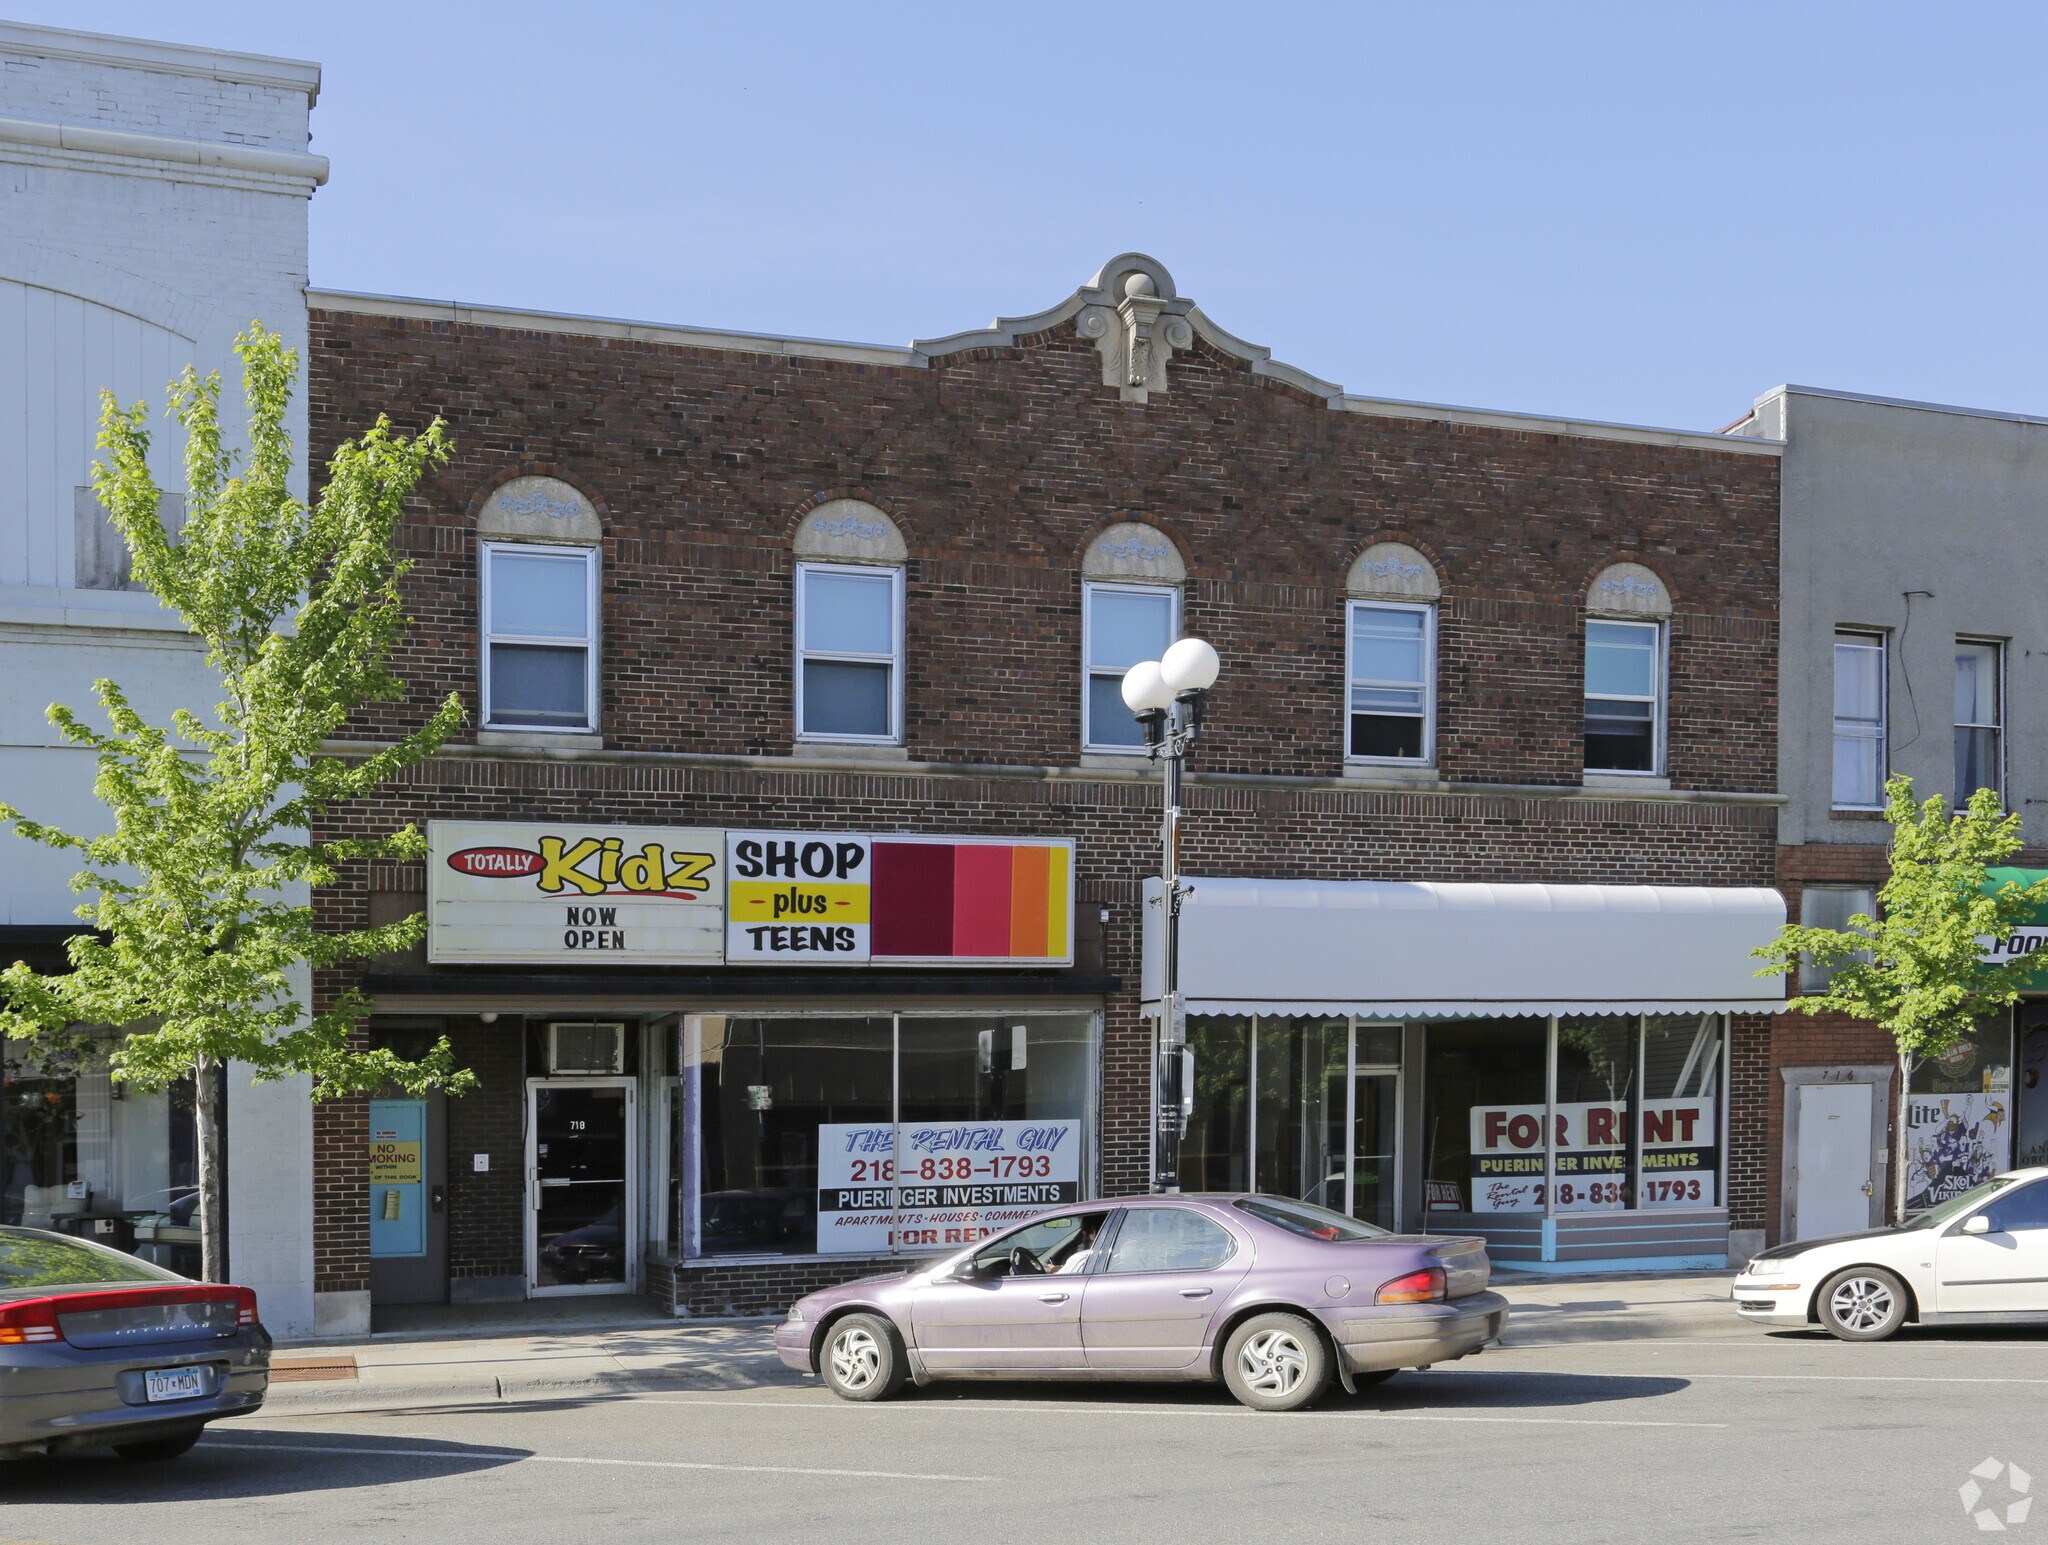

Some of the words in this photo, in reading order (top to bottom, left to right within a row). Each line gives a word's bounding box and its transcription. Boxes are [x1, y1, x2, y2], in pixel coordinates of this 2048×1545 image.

[462, 852, 534, 872] TOTALLY
[536, 836, 716, 896] Kidz
[735, 840, 864, 880] SHOP
[773, 887, 827, 919] plus
[566, 907, 618, 927] NOW
[564, 929, 626, 950] OPEN
[746, 926, 855, 952] TEENS
[1992, 935, 2048, 955] FOO
[1822, 1070, 1854, 1081] 716
[570, 1120, 586, 1130] 718
[1906, 1104, 1941, 1129] Lite
[845, 1128, 900, 1153] THE
[911, 1126, 1005, 1153] RENTAL
[1016, 1125, 1069, 1152] GUY
[1484, 1110, 1570, 1149] FOR
[369, 1154, 416, 1164] MOKING
[377, 1144, 396, 1154] NO
[1480, 1157, 1578, 1173] PUERINER
[1583, 1153, 1699, 1170] INVEMENTS
[1425, 1183, 1441, 1201] FOR
[1440, 1184, 1460, 1201] RENT
[1488, 1182, 1510, 1192] The
[1532, 1179, 1701, 1205] 28-831793
[1943, 1174, 1974, 1191] SKOL
[942, 1184, 1061, 1206] INVESTMENTS
[1927, 1183, 1963, 1203] VIKIN
[929, 1211, 979, 1223] HOUSES
[984, 1209, 1044, 1222] COMMER
[887, 1229, 941, 1246] FOR
[944, 1226, 1005, 1244] REN
[149, 1376, 170, 1394] 707
[177, 1373, 199, 1390] MDN
